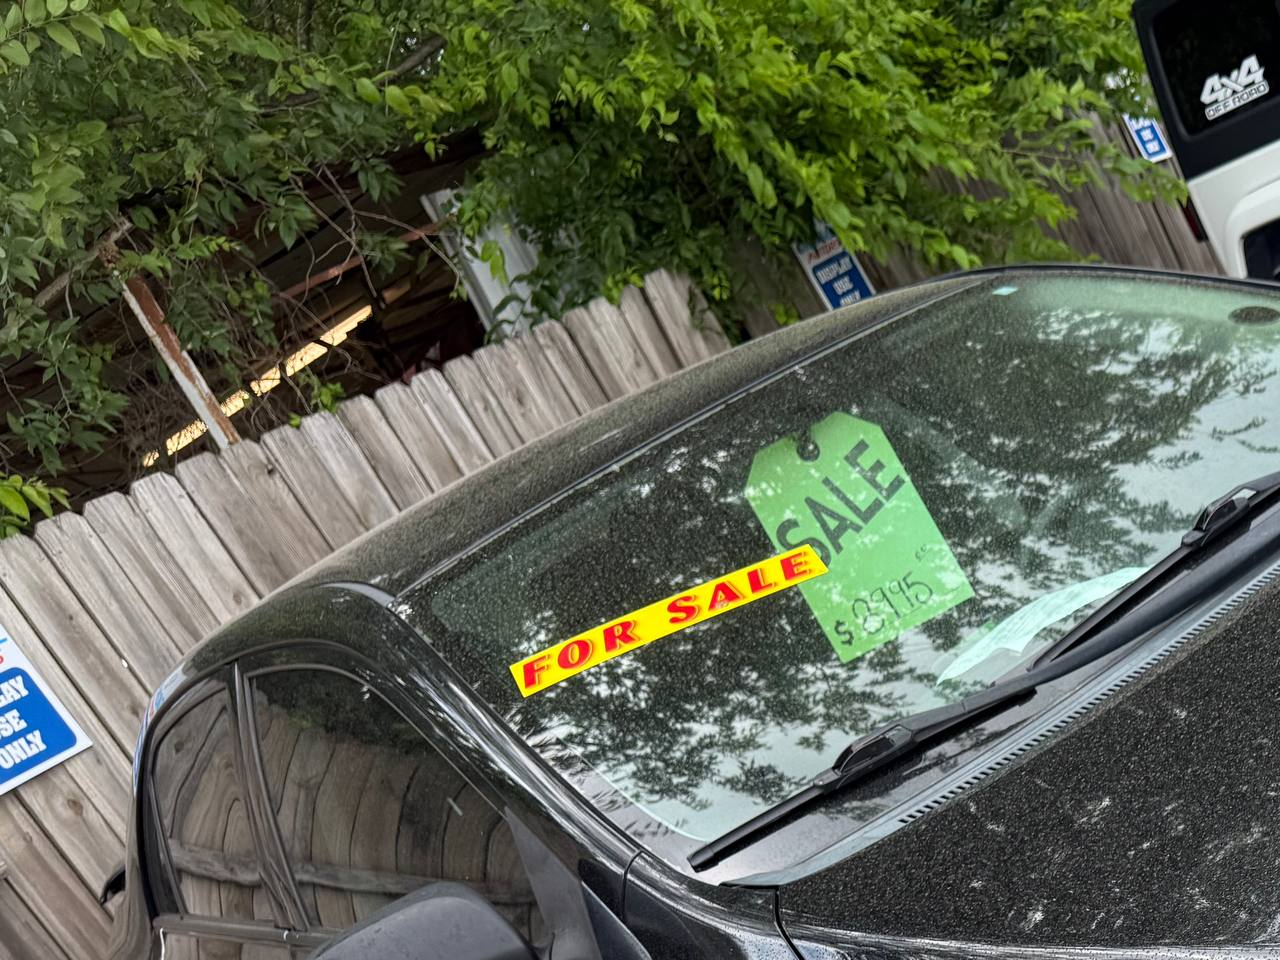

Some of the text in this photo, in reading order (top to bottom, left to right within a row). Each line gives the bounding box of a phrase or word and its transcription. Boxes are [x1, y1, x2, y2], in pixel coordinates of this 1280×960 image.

[1206, 83, 1267, 118] OFF ROAD
[775, 438, 906, 567] SALE
[522, 551, 813, 689] FOR SALE
[0, 729, 47, 769] ONLY
